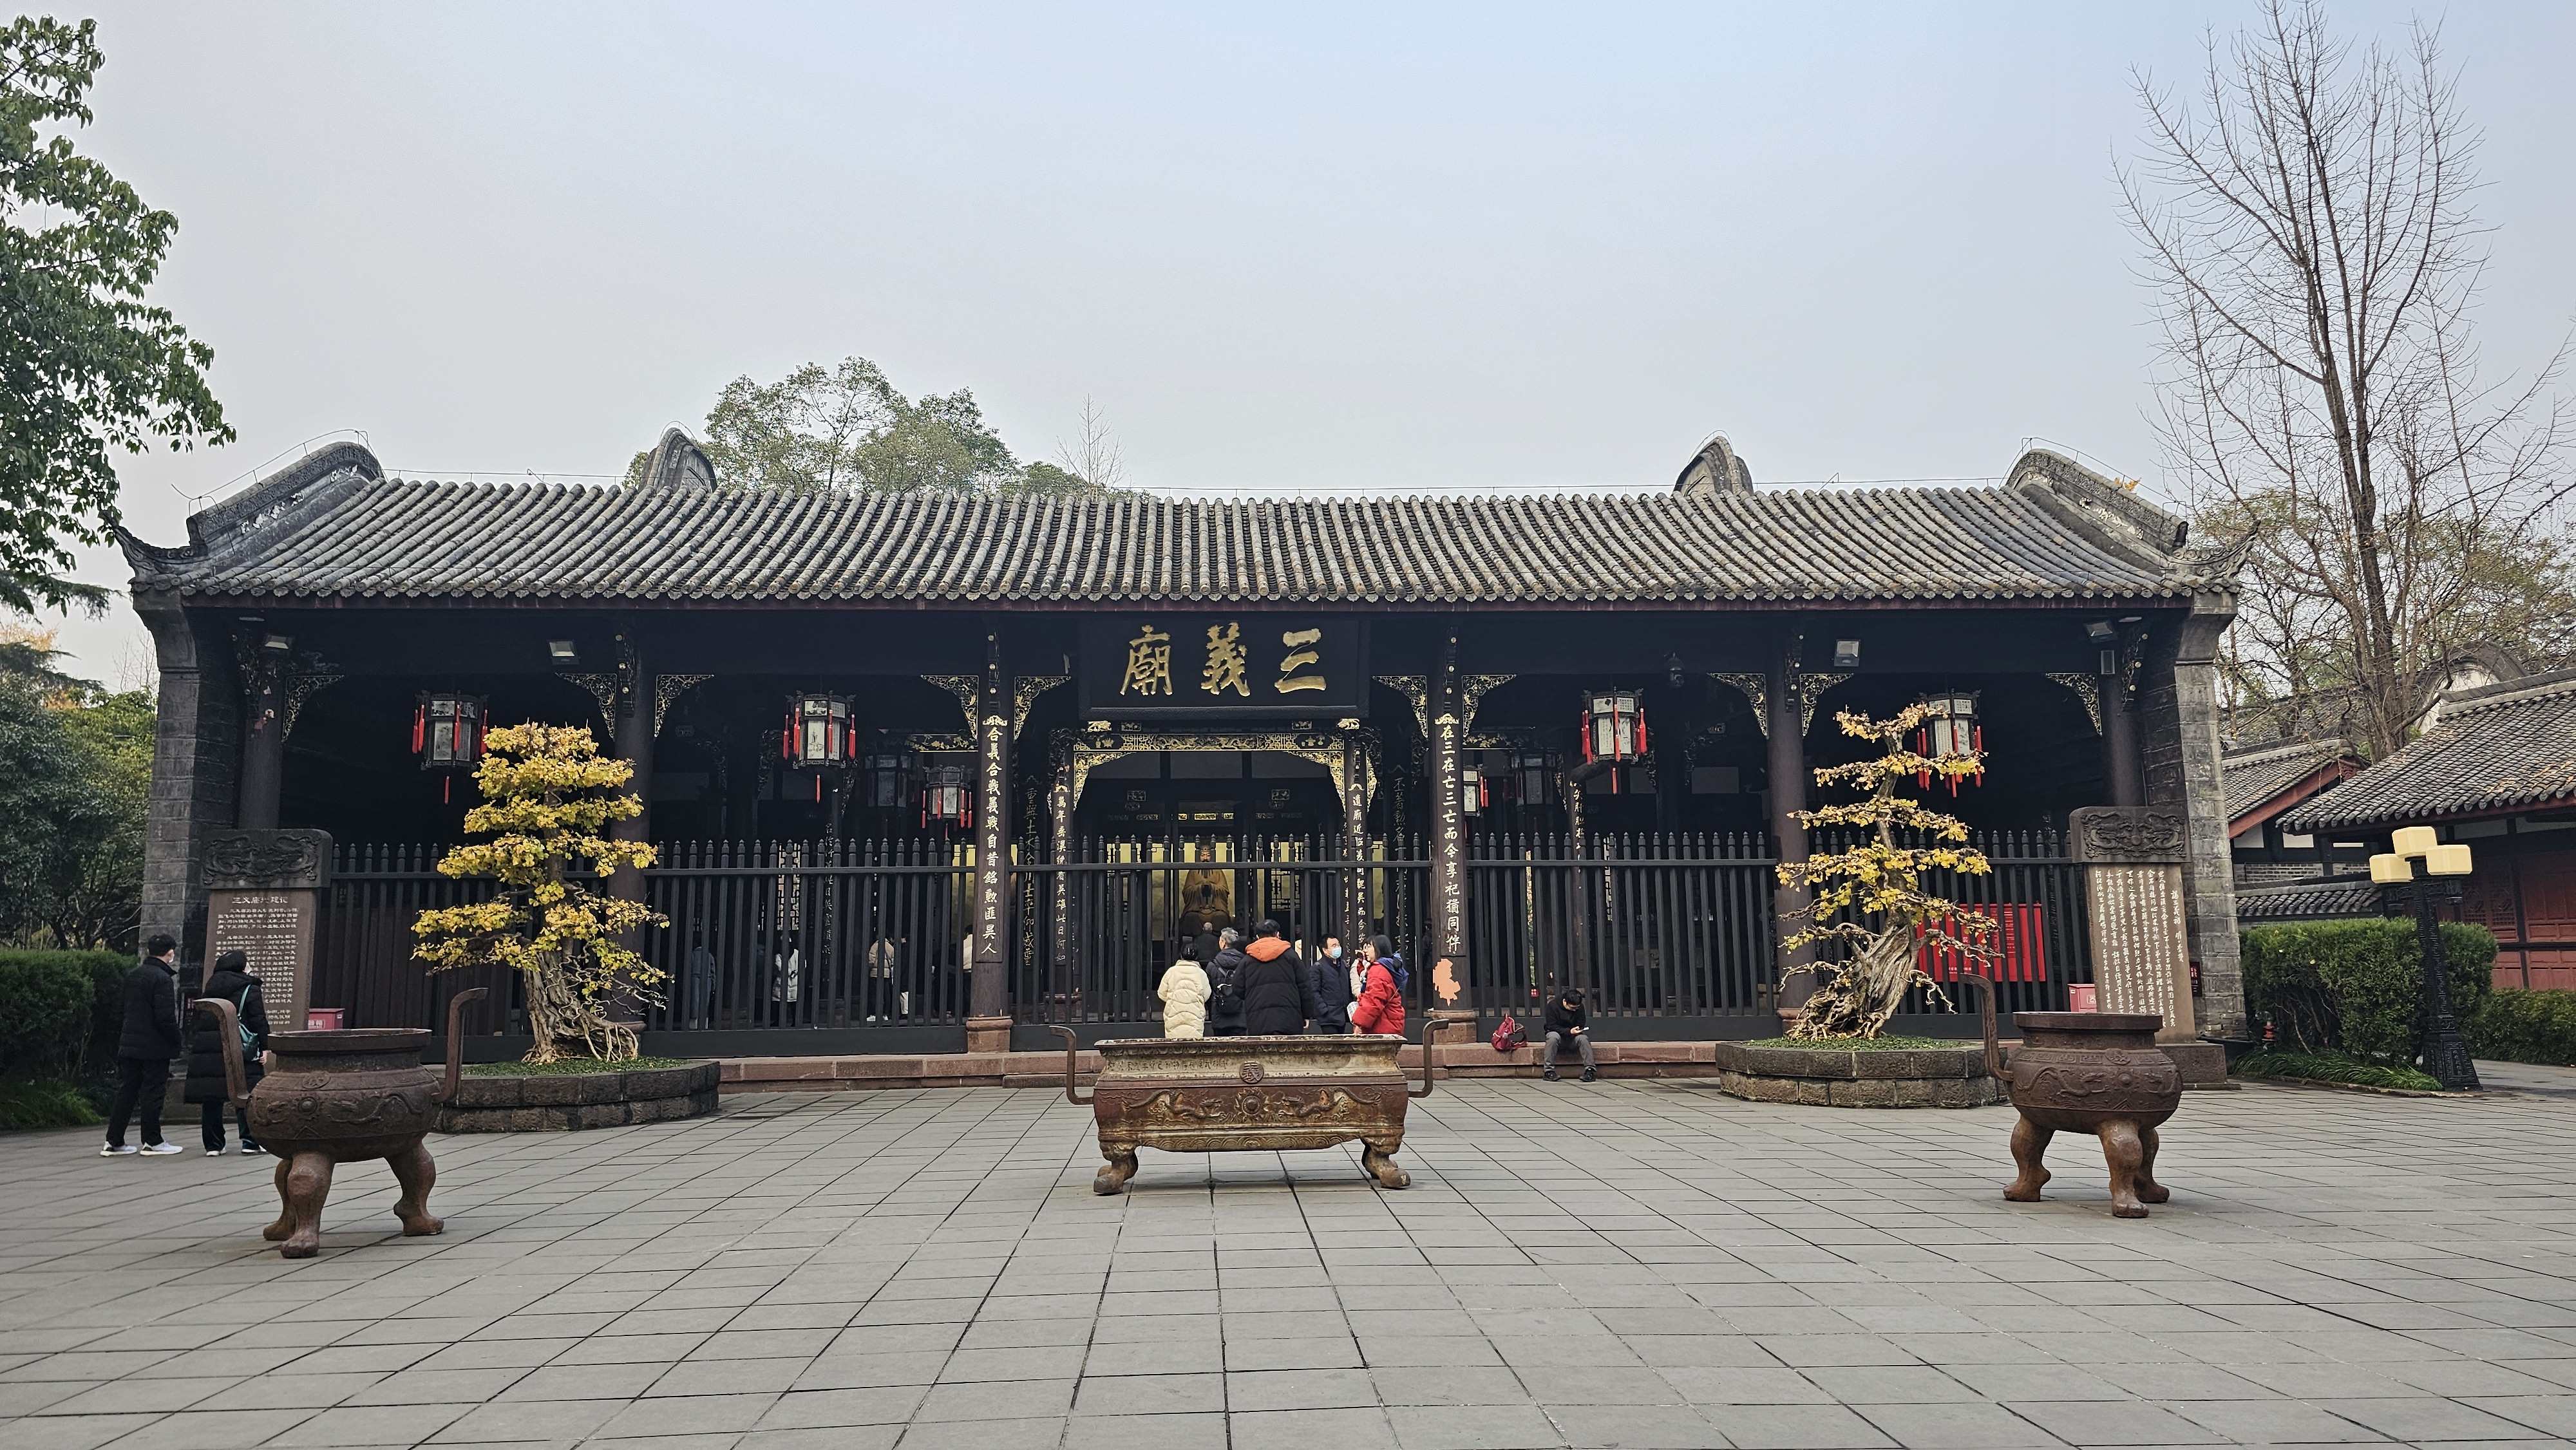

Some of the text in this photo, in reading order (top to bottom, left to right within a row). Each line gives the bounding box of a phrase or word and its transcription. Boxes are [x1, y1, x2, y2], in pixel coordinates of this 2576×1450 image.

[1119, 621, 1327, 697] 三義廟
[1241, 1060, 1262, 1082] 義
